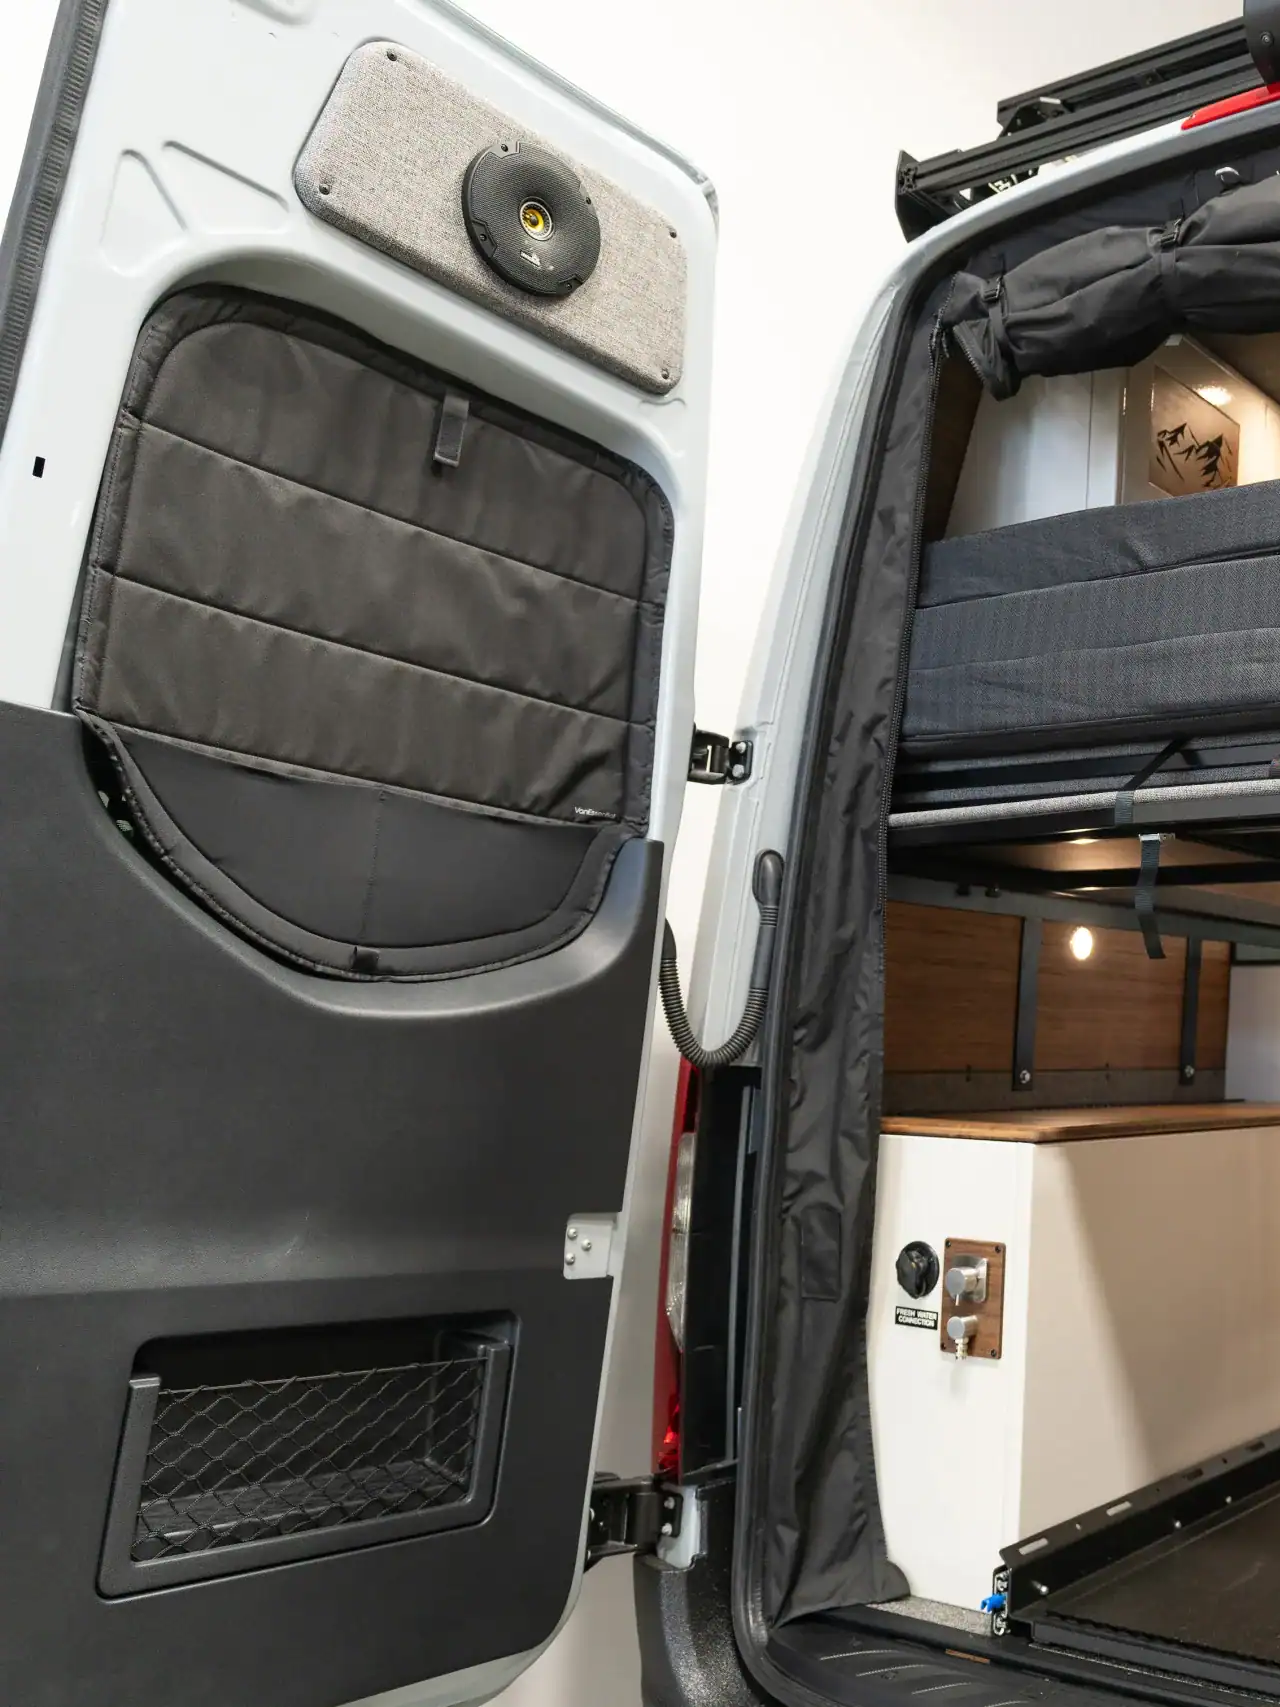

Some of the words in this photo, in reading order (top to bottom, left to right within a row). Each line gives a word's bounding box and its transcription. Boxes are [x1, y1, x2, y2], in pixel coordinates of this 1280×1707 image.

[896, 1307, 916, 1317] FRESH
[917, 1310, 938, 1320] WATER
[898, 1315, 935, 1327] CONNECTION
